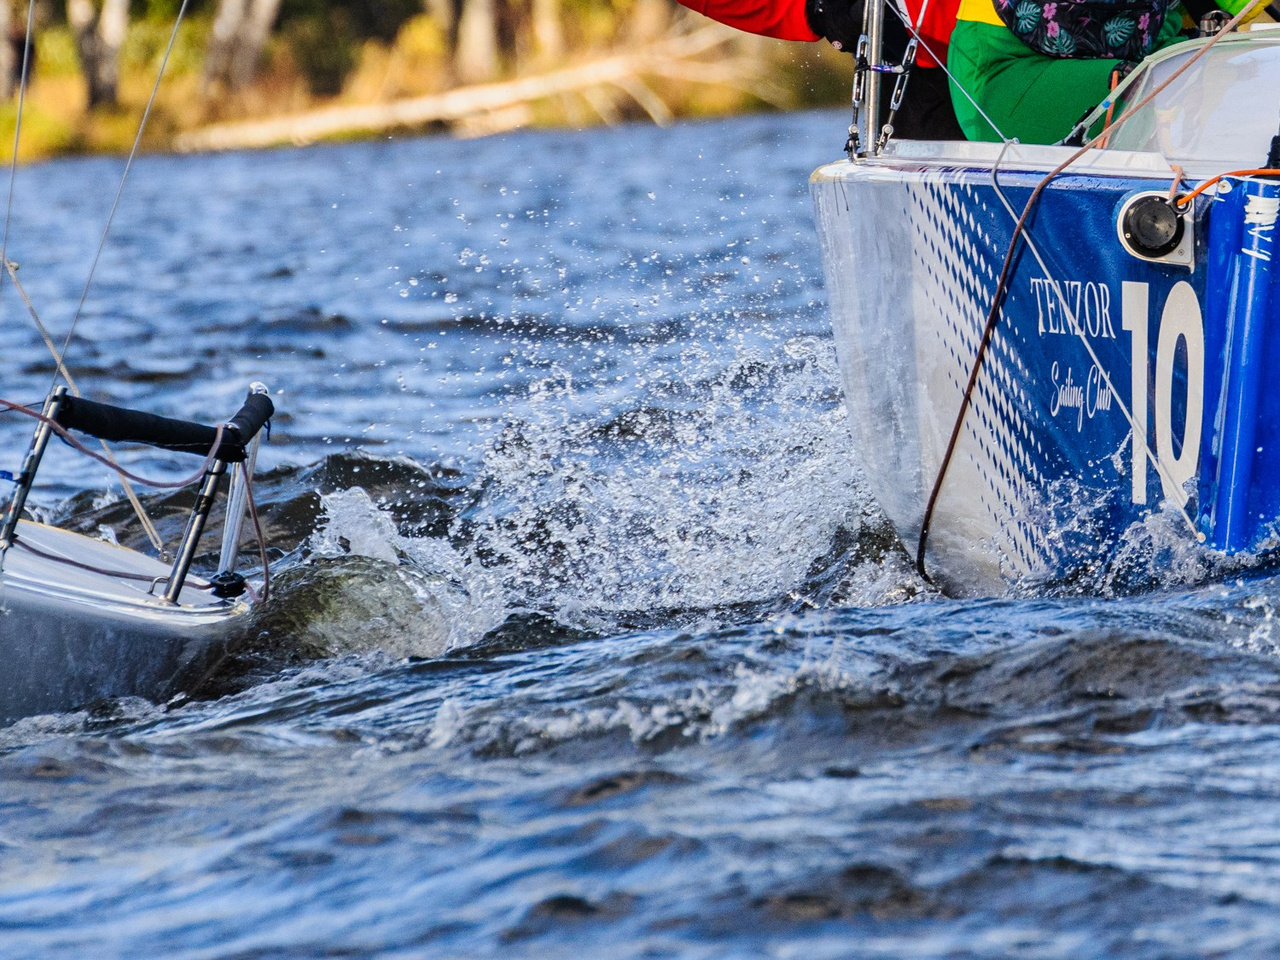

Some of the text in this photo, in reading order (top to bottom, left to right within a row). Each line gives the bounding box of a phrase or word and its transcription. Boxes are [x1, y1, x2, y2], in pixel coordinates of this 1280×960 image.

[1030, 277, 1116, 338] TENZOR
[1050, 360, 1112, 432] Sailing Club
[1121, 280, 1204, 505] 10
